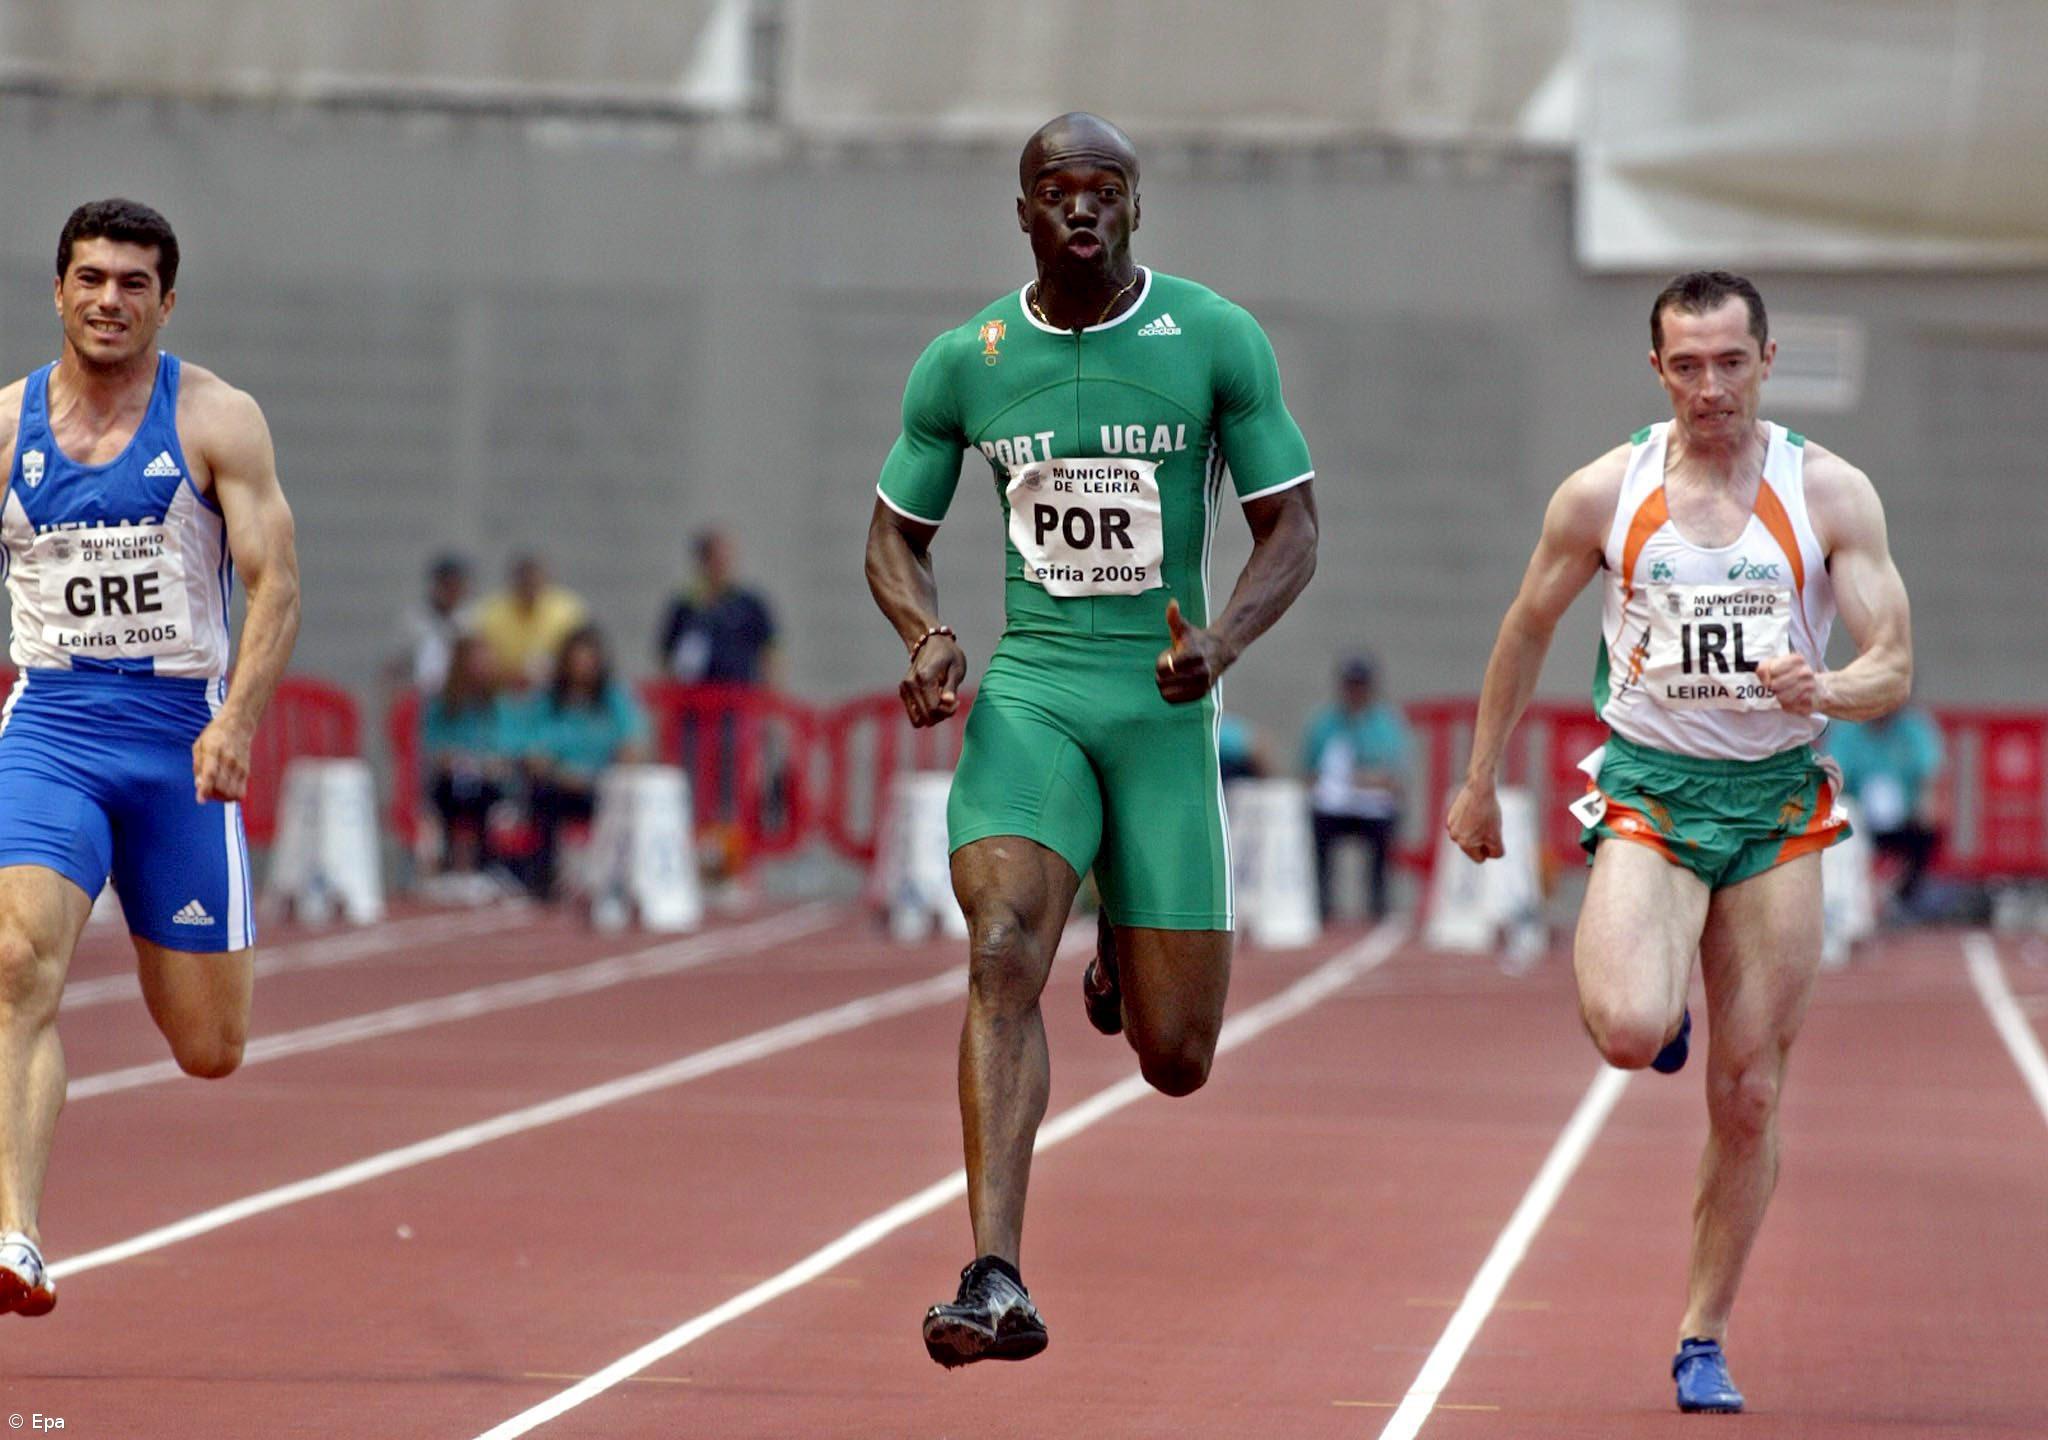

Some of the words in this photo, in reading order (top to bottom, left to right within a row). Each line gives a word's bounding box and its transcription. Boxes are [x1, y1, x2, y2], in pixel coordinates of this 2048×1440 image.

[980, 431, 1055, 468] PORT
[1100, 424, 1187, 454] UGAL
[1052, 466, 1140, 480] MUNICÍPIO
[1054, 480, 1073, 493] DE
[1083, 481, 1140, 494] LEIRIA
[1034, 503, 1134, 550] POR
[83, 550, 103, 562] DE
[112, 545, 164, 561] LEIRIA
[1034, 564, 1084, 582] eiria
[1091, 566, 1146, 582] 2005
[64, 571, 162, 618] GRE
[1694, 606, 1713, 617] DE
[1722, 606, 1773, 617] LEIRIA
[58, 631, 117, 648] Leiria
[124, 624, 177, 645] 2005
[1682, 622, 1759, 675] IRL
[1666, 684, 1729, 699] LEIRIA
